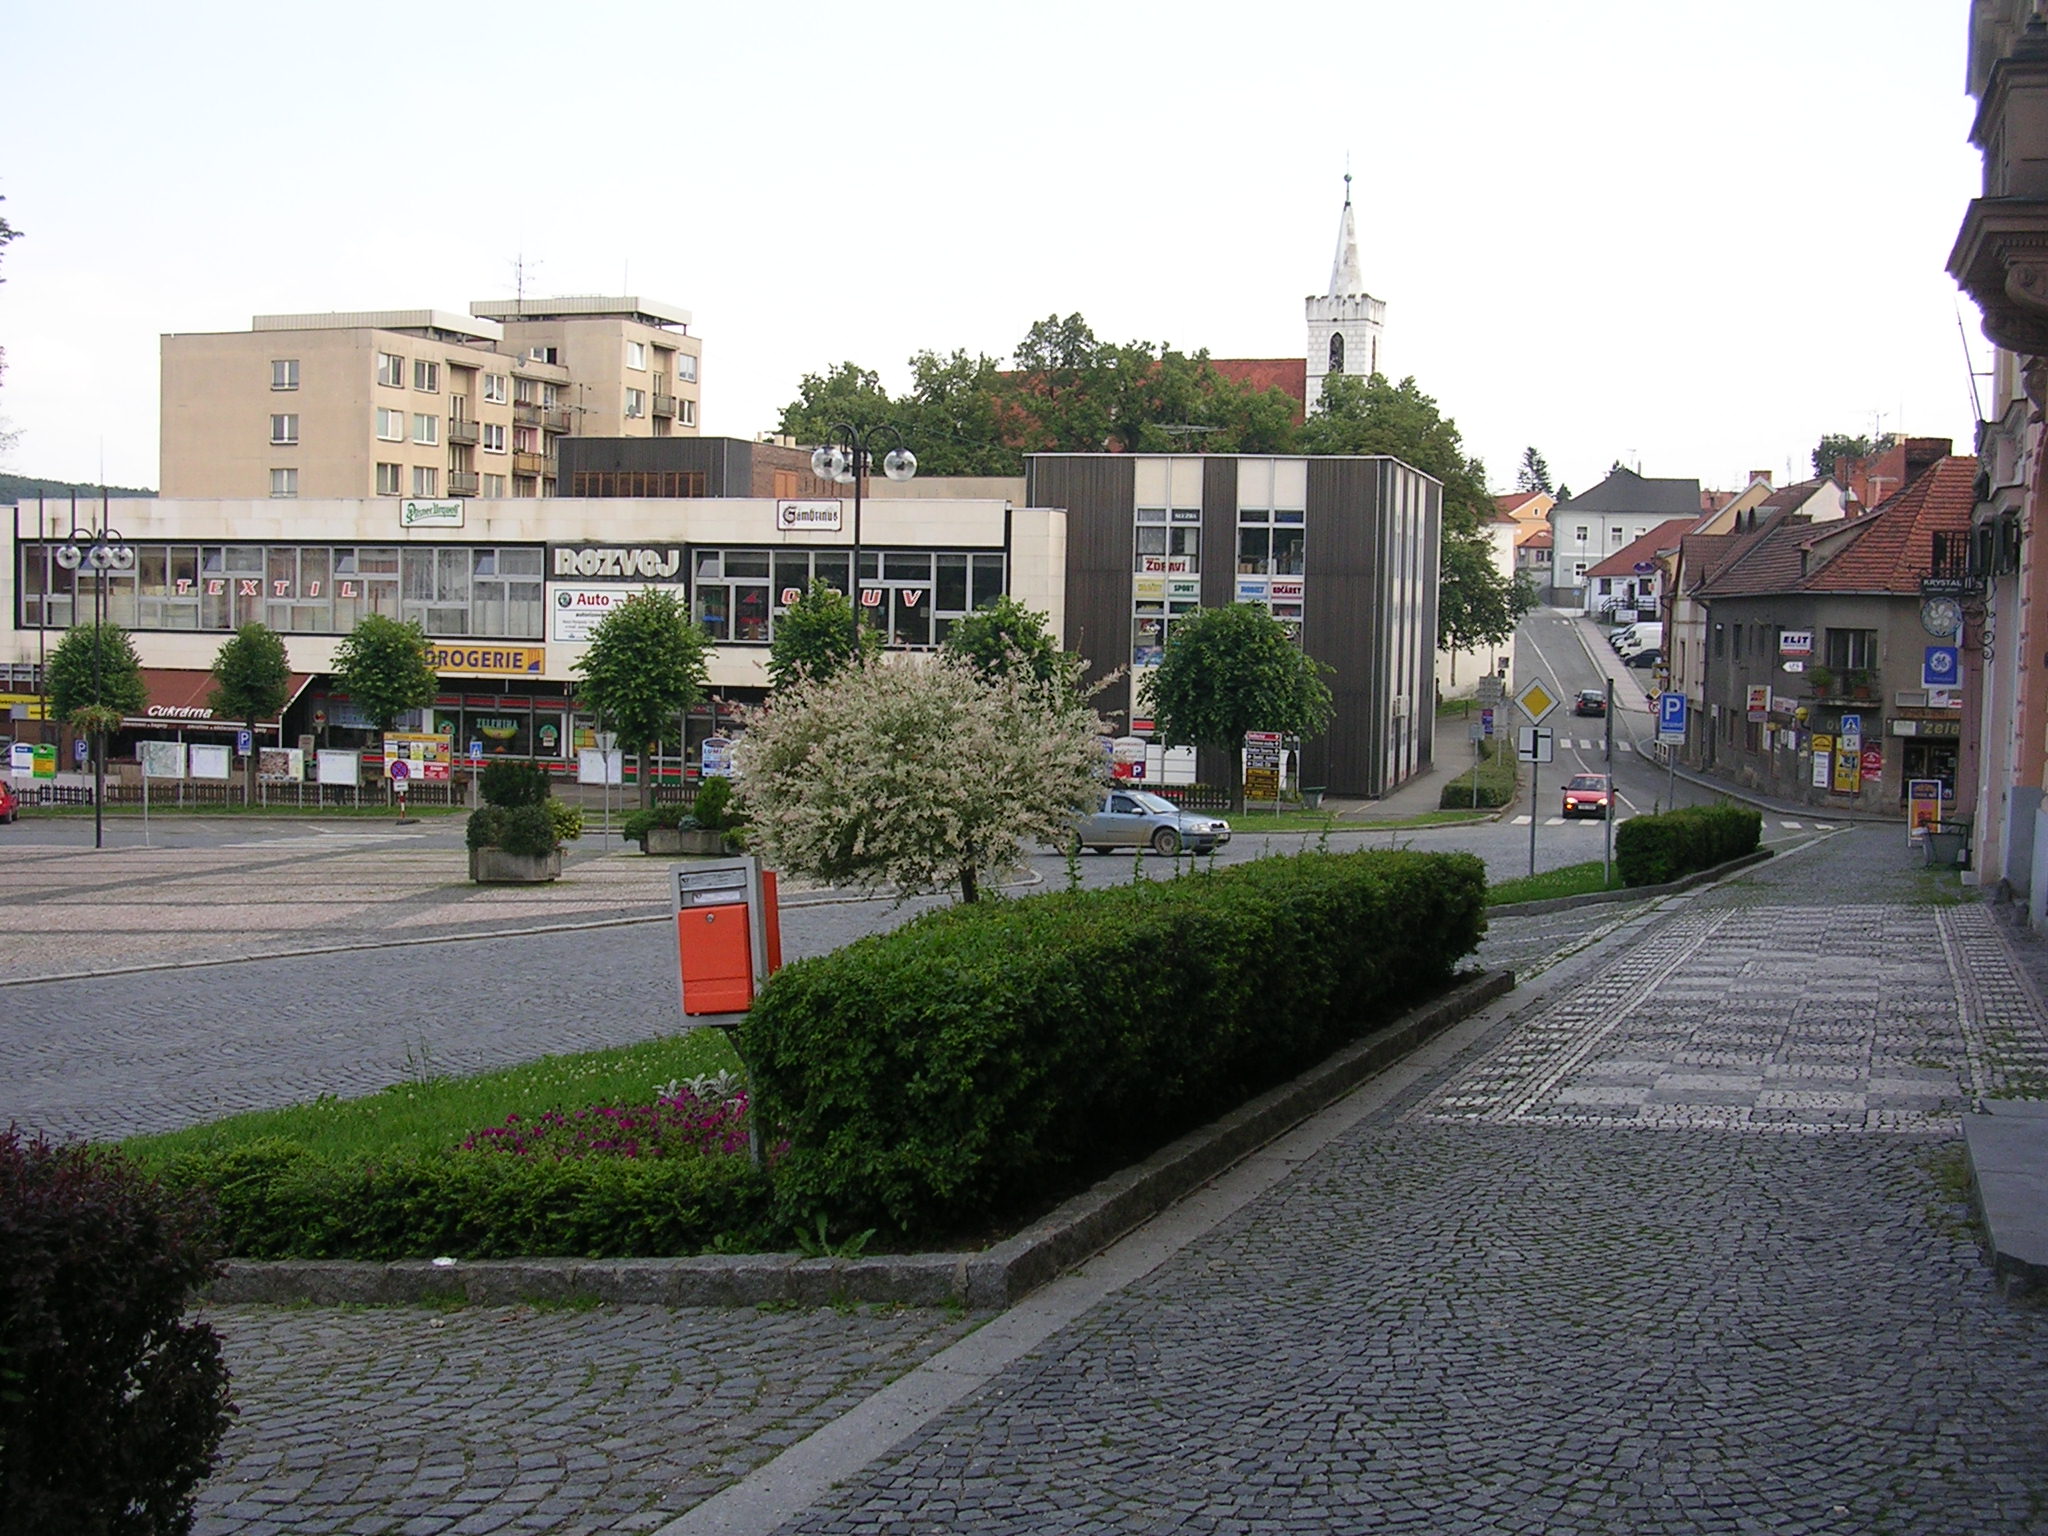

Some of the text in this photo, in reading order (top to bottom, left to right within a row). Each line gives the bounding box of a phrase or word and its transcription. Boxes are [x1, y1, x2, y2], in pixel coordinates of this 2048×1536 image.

[782, 506, 838, 524] Gambrinus
[554, 548, 680, 577] ROZVOJ
[176, 578, 358, 598] TEXTIL
[1174, 584, 1194, 592] SPORT
[1923, 579, 1962, 587] KRYSTAL
[576, 593, 610, 606] Auto
[424, 649, 524, 669] DROGERIE
[147, 704, 214, 719] Cukrárna
[1665, 697, 1681, 720] P
